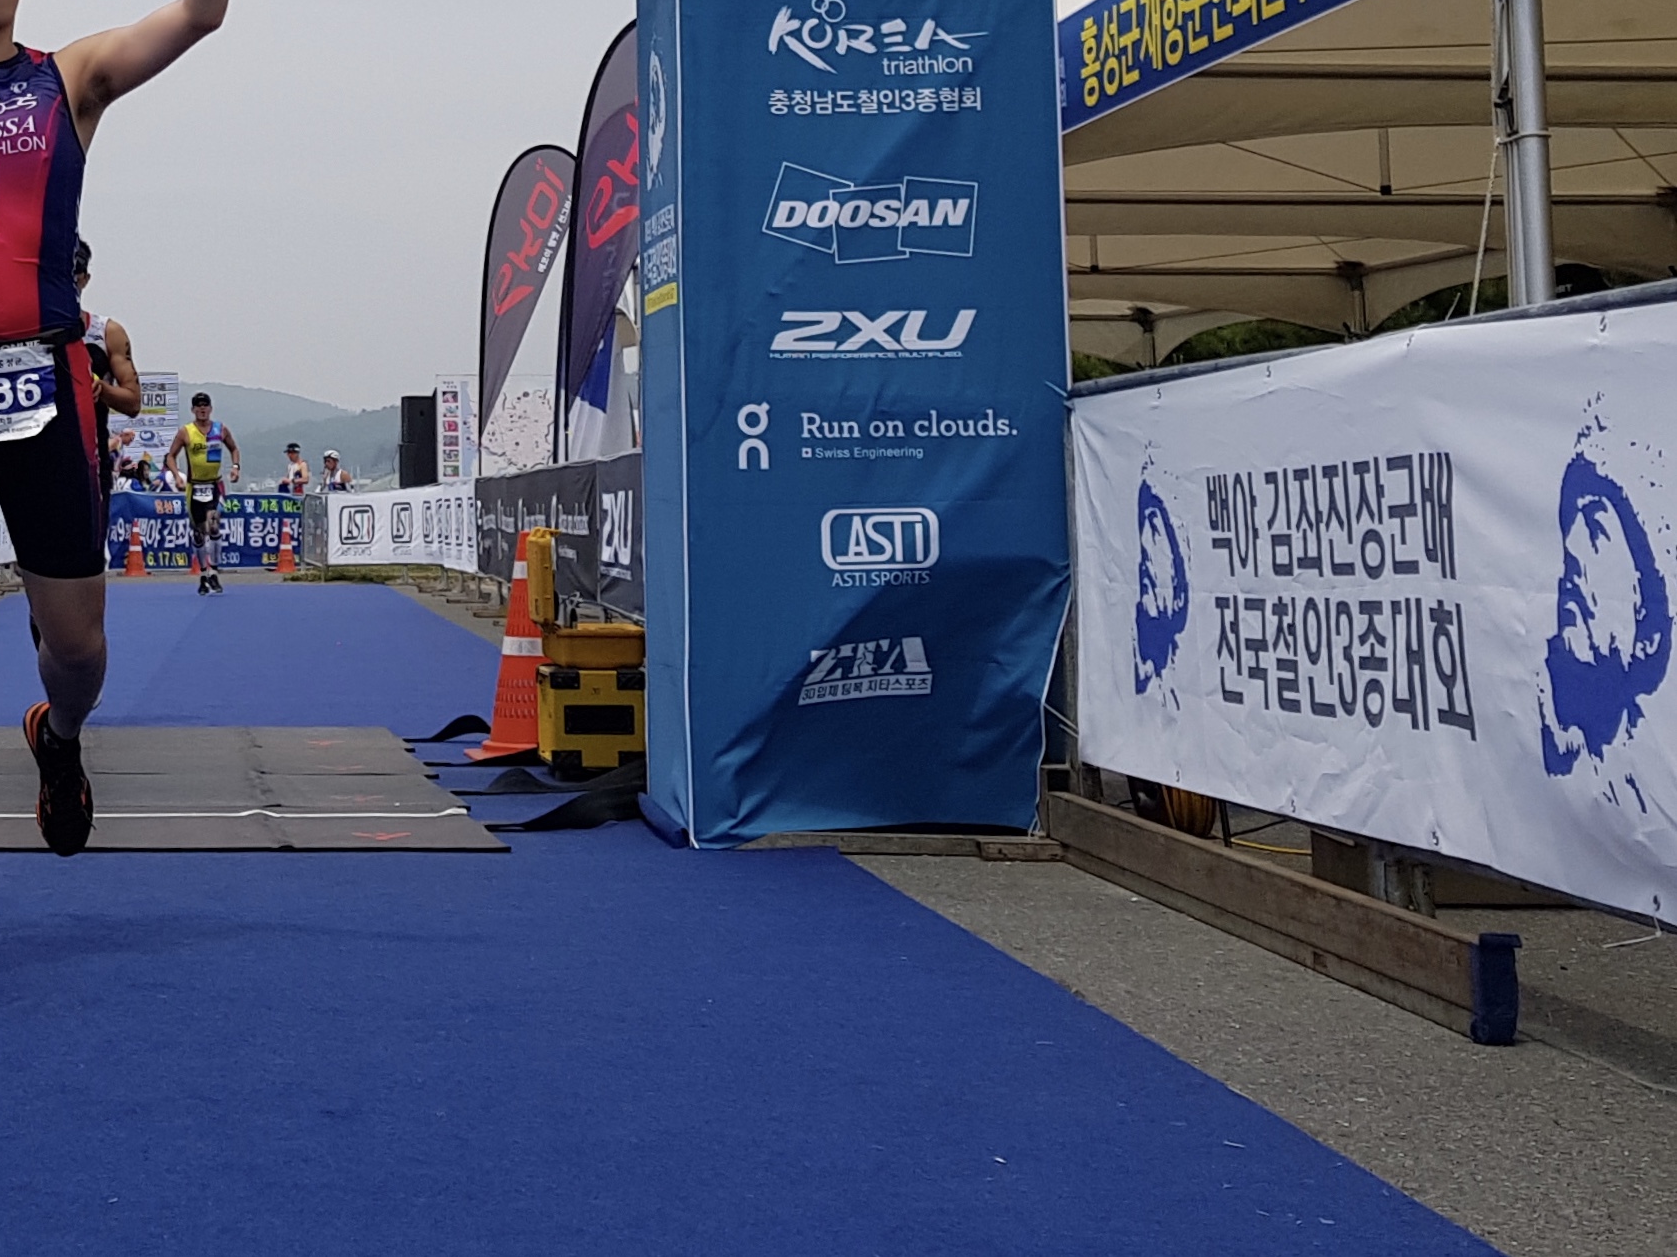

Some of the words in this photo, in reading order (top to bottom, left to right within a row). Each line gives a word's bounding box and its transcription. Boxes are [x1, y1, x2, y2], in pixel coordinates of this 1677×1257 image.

[881, 55, 973, 76] triathlon
[767, 86, 982, 115] 충청남도철인3종협회
[771, 198, 971, 229] DOOSAN
[769, 308, 978, 352] 2XU
[800, 411, 861, 438] Run
[869, 419, 905, 437] on
[913, 409, 1018, 437] clouds.
[815, 447, 851, 459] Swiss
[853, 446, 924, 460] Engineering
[601, 489, 634, 565] 2XU
[1206, 470, 1260, 578] 백야
[1265, 452, 1457, 581] 김좌진장군배
[249, 517, 279, 548] 홍성
[835, 514, 923, 562] ASTI
[831, 572, 867, 588] ASTI
[870, 571, 931, 587] SPORTS
[1213, 593, 1478, 742] 전국철인3종대회
